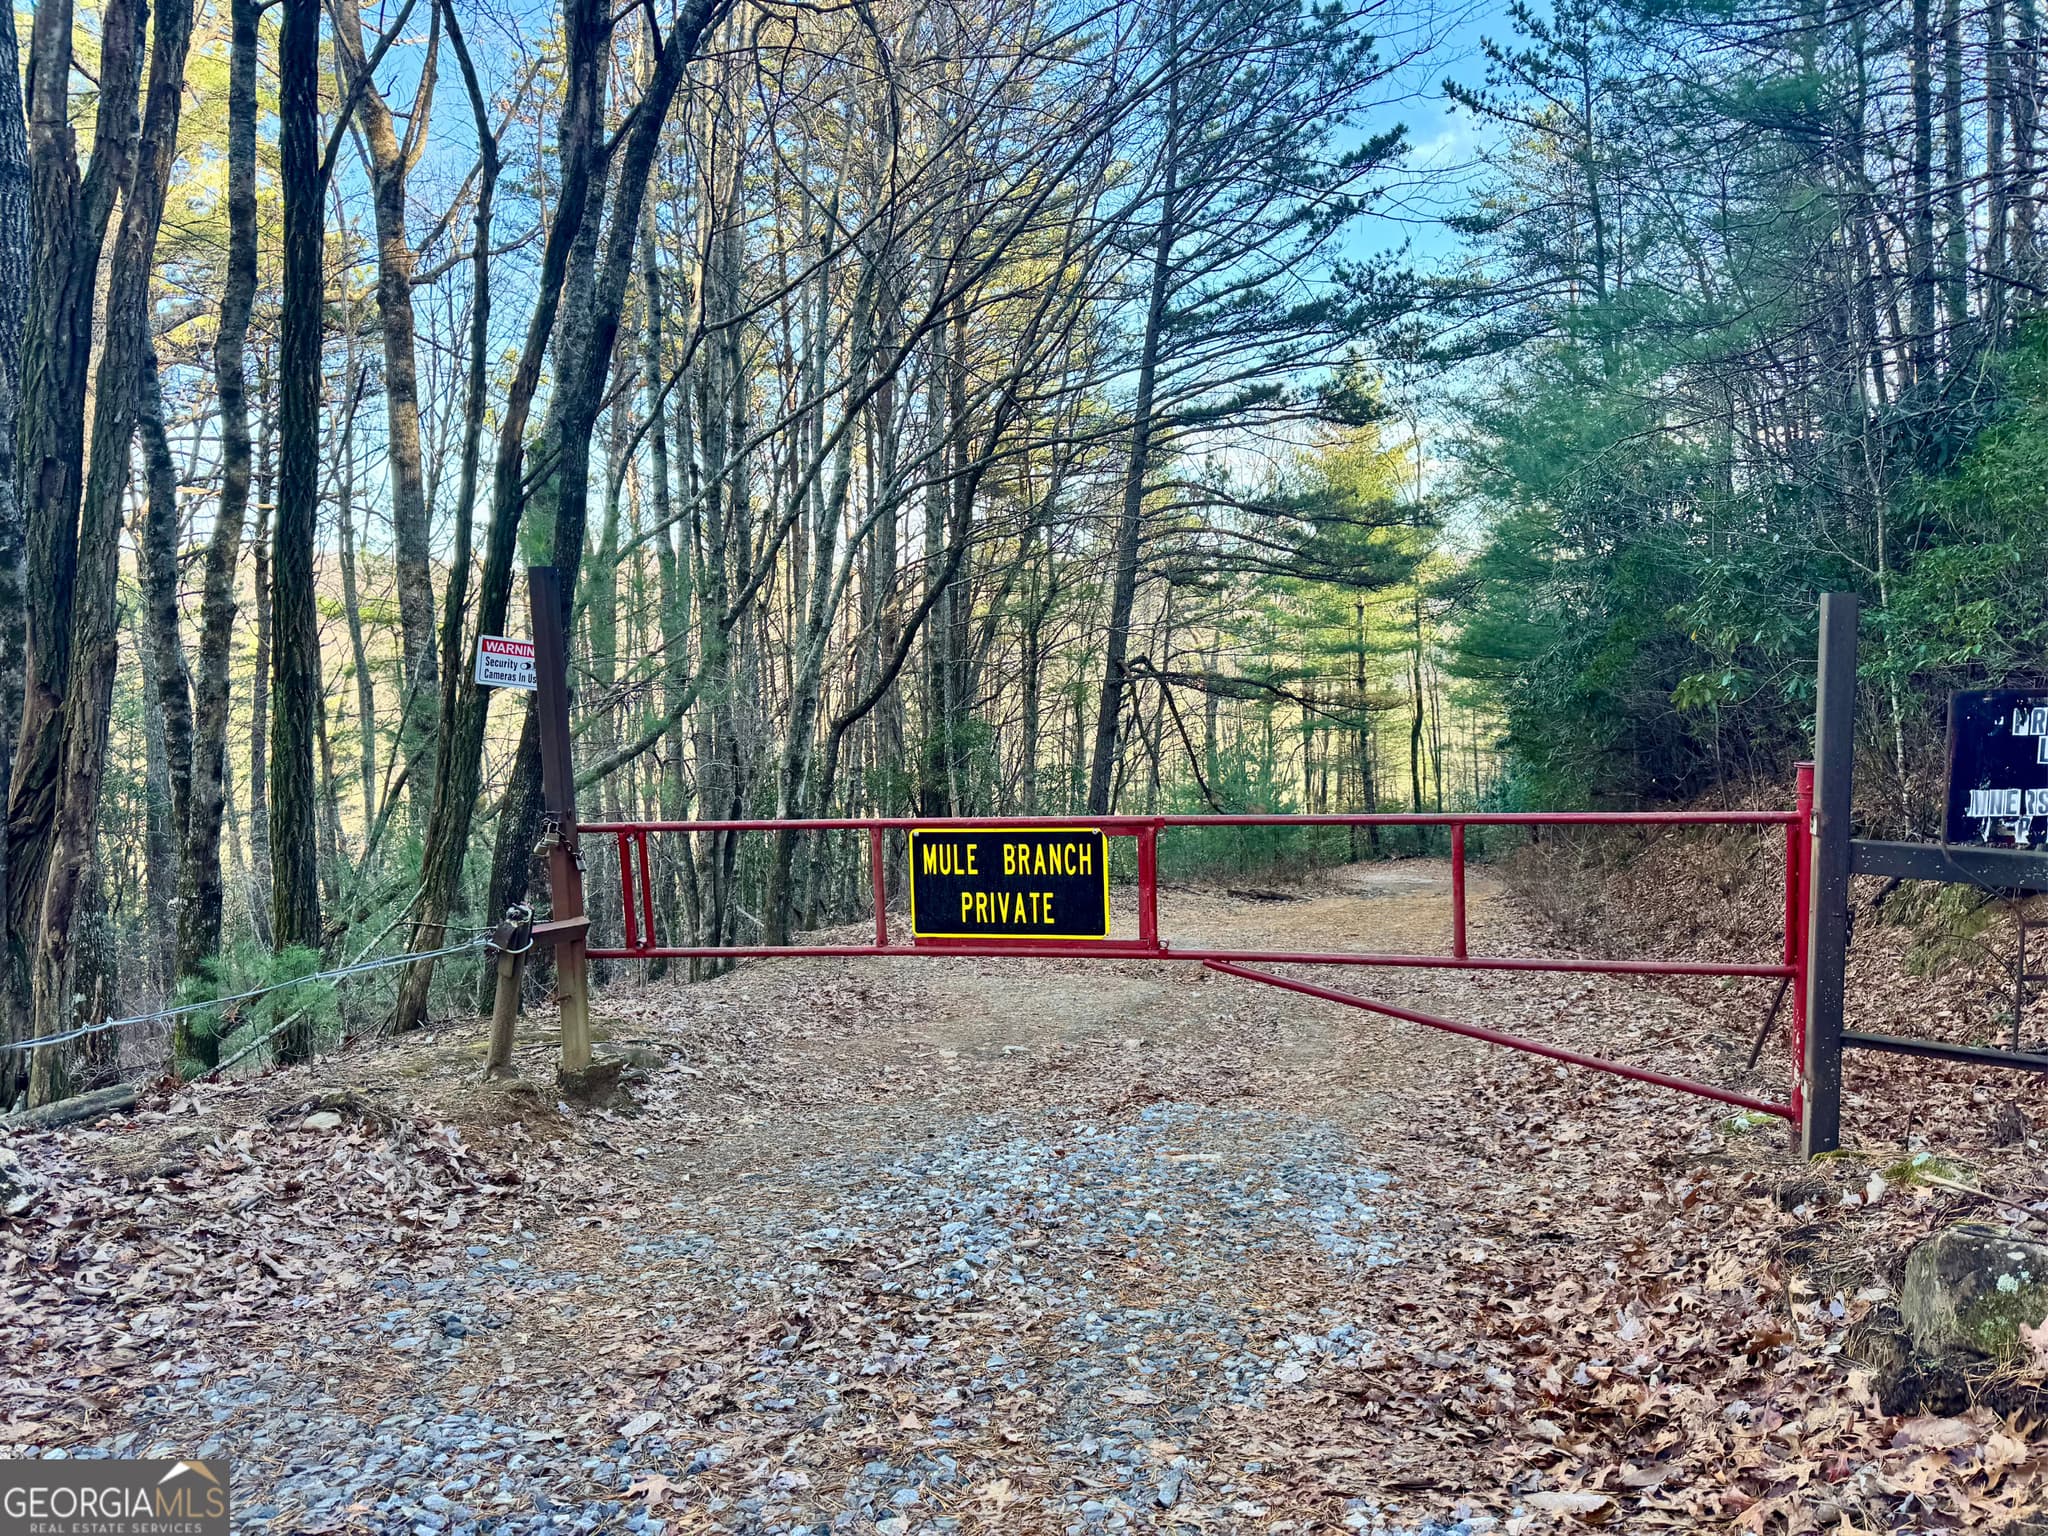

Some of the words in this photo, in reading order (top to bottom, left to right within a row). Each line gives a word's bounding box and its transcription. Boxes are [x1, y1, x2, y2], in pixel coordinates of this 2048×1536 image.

[486, 641, 535, 657] WARNIN
[485, 656, 518, 671] Security
[484, 668, 517, 682] Cameras
[518, 672, 526, 682] In
[528, 673, 537, 684] Us
[922, 843, 979, 876] MULE
[1003, 843, 1093, 876] BRANCH
[961, 892, 1055, 924] PRIVATE
